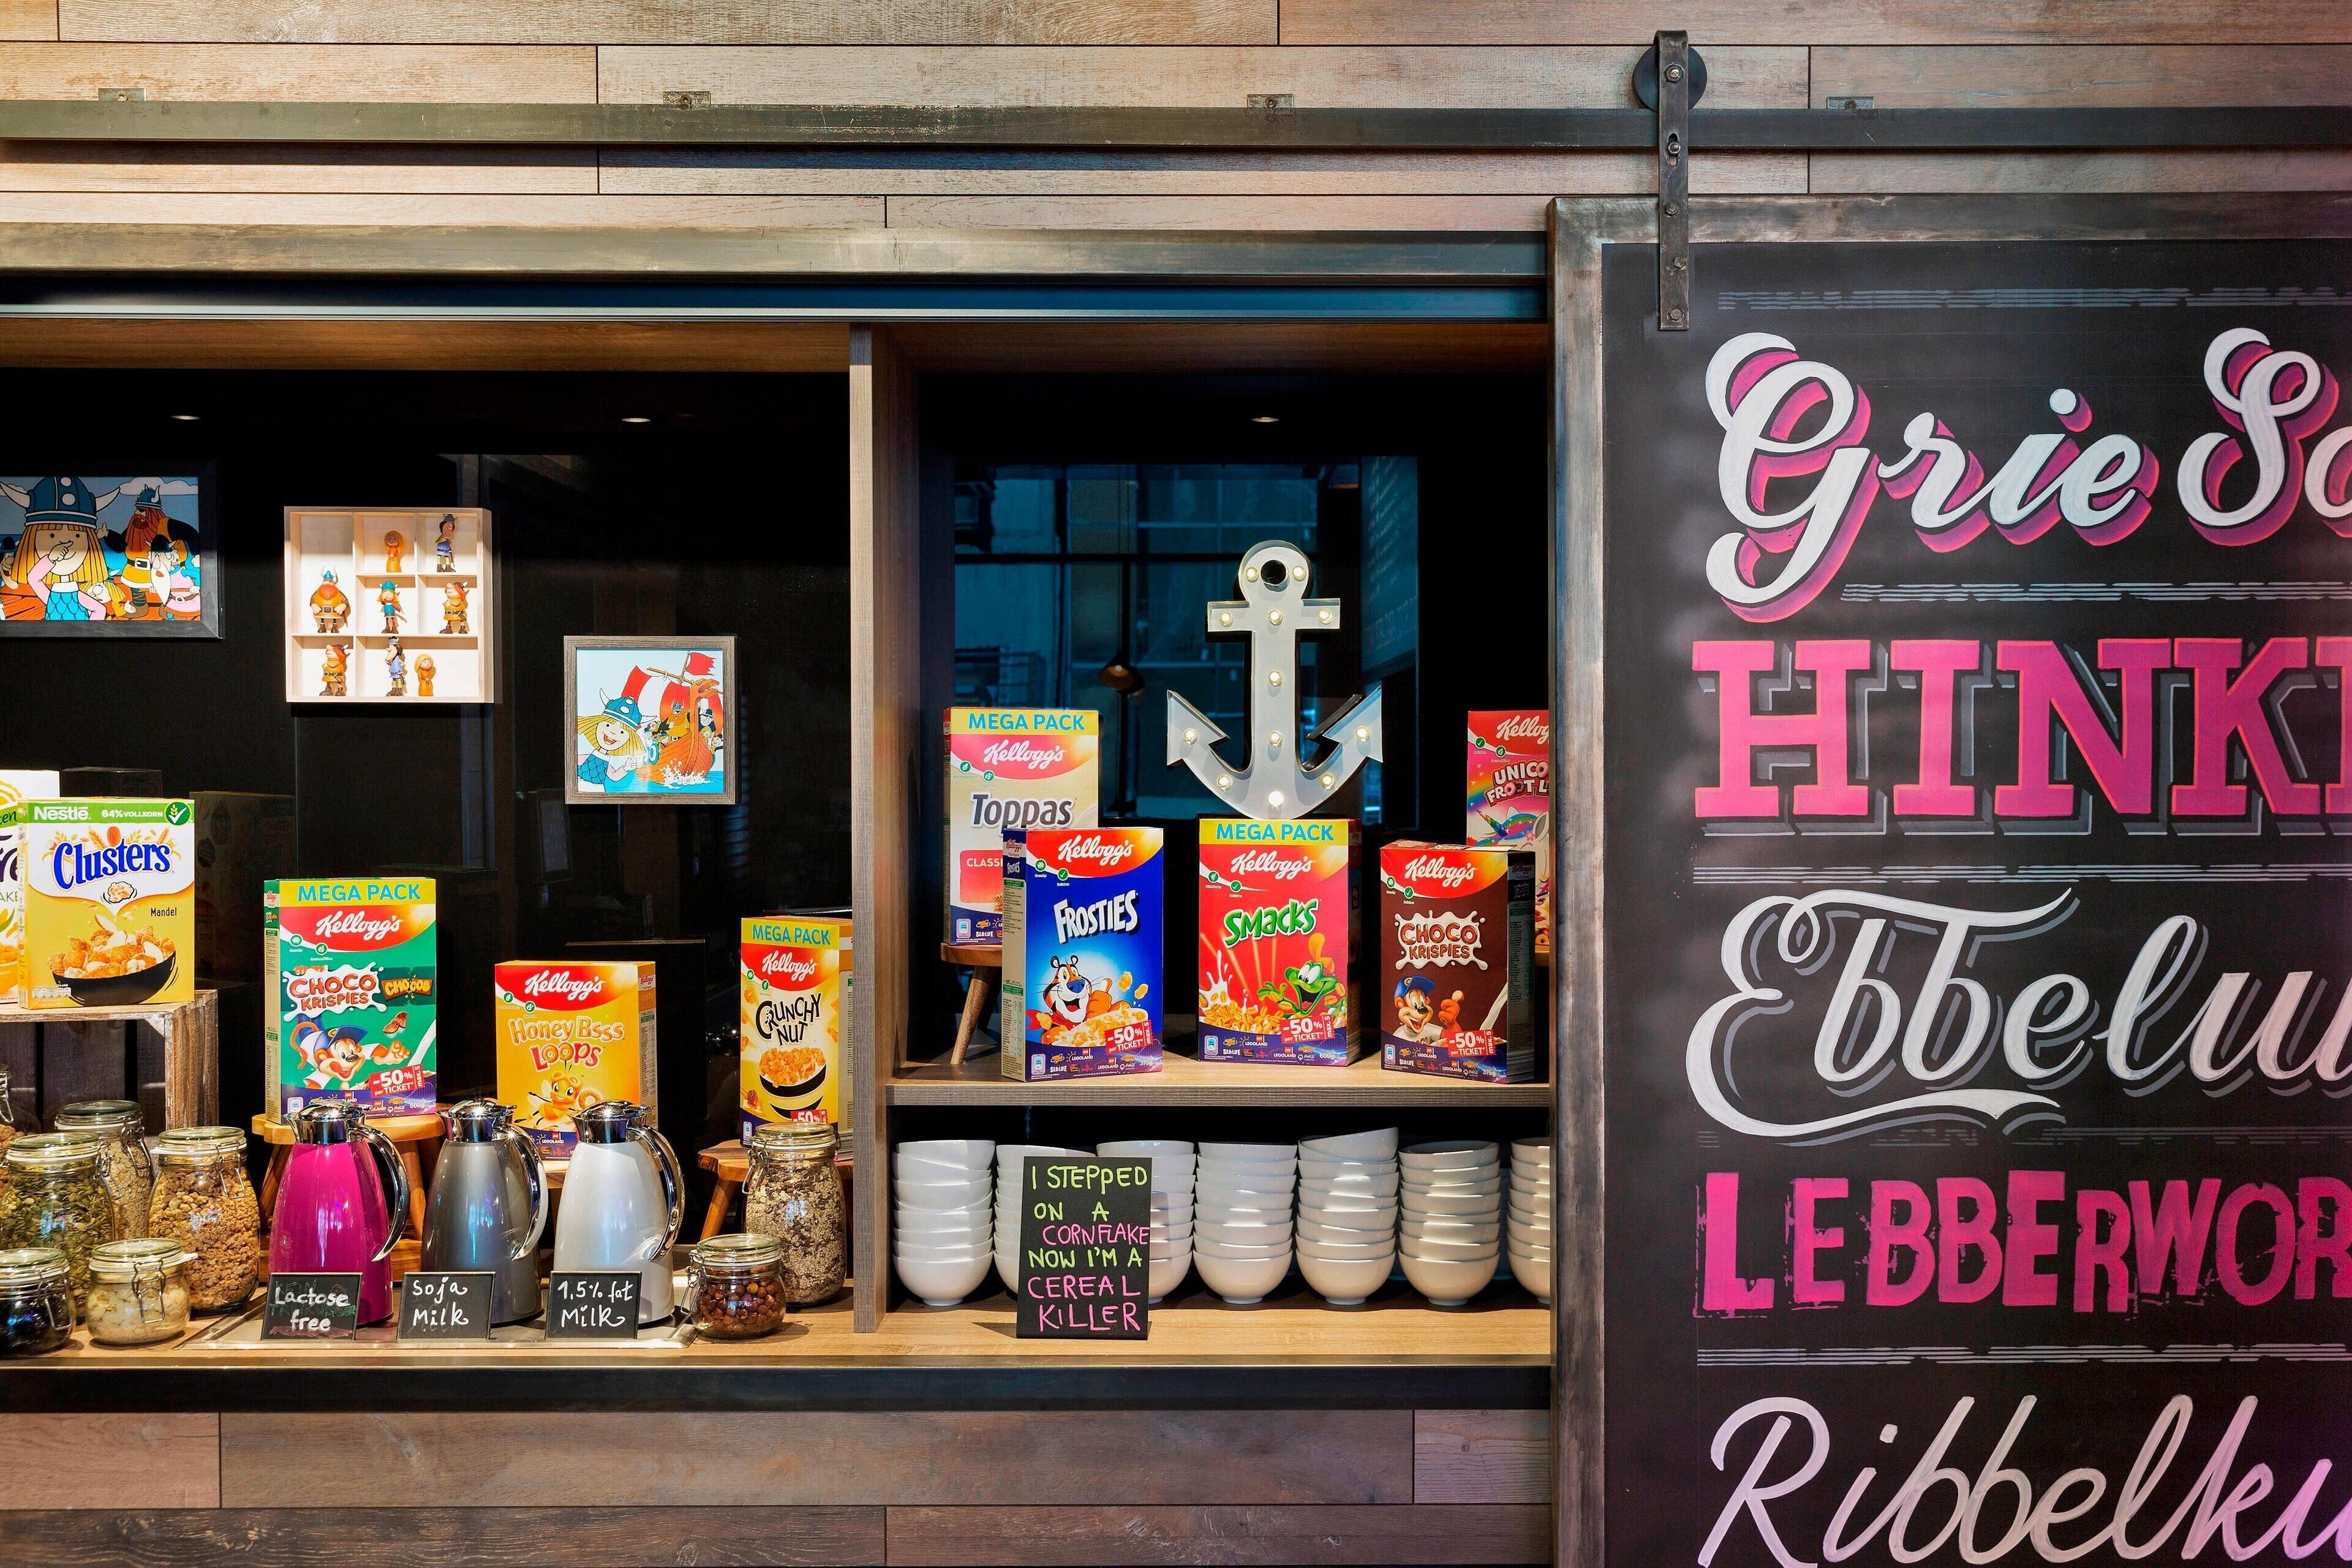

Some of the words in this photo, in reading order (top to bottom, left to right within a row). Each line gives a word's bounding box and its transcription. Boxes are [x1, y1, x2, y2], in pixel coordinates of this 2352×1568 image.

[1705, 331, 2158, 622] Grie
[968, 714, 1028, 729] MEGA
[1034, 714, 1085, 730] PACK
[1496, 715, 1549, 745] Kellog
[984, 739, 1065, 770] Kellogg's
[34, 806, 89, 820] Nestlé
[973, 794, 1072, 834] Toppas
[1216, 824, 1275, 840] MEGA
[1281, 824, 1334, 840] PACK
[1058, 835, 1133, 866] Kellogg's
[53, 839, 171, 889] Clusters
[1231, 850, 1313, 880] Kellogg's
[1404, 855, 1476, 888] Kellogg's
[298, 885, 361, 902] MEGA
[368, 884, 420, 900] PACK
[151, 907, 177, 918] Mandel
[1054, 890, 1138, 944] FROSTIES
[315, 910, 402, 941] Kellogg's
[753, 924, 791, 943] MEGA
[794, 927, 831, 945] PACK
[1400, 922, 1478, 945] CHOCO
[1409, 944, 1471, 960] KRISPIES
[762, 950, 816, 982] Kellogg's
[289, 973, 377, 998] CHOCO
[524, 970, 603, 1001] Kellogg's
[301, 992, 369, 1011] KRISPIES
[756, 993, 821, 1040] CRUNCHY
[1283, 1018, 1322, 1035] -50%
[508, 1019, 573, 1046] Honey
[576, 1016, 624, 1041] Bsss
[776, 1020, 808, 1046] NUT
[1107, 1025, 1143, 1044] -50%
[1449, 1031, 1485, 1049] -50%
[1032, 1166, 1036, 1189] I
[1047, 1165, 1148, 1194] STEPPED
[1034, 1202, 1063, 1221] ON
[1091, 1201, 1109, 1222] A
[1042, 1223, 1150, 1246] CORNFLAKE
[1028, 1248, 1076, 1268] NOW
[1087, 1246, 1117, 1267] I'M
[1127, 1247, 1142, 1267] A
[275, 1287, 351, 1307] Lactose
[413, 1276, 468, 1303] Soja
[608, 1280, 633, 1303] fat
[1028, 1275, 1141, 1300] CEREAL
[290, 1309, 331, 1332] free
[413, 1302, 469, 1326] Milk
[562, 1305, 625, 1328] Milk
[1039, 1302, 1140, 1332] KILLER
